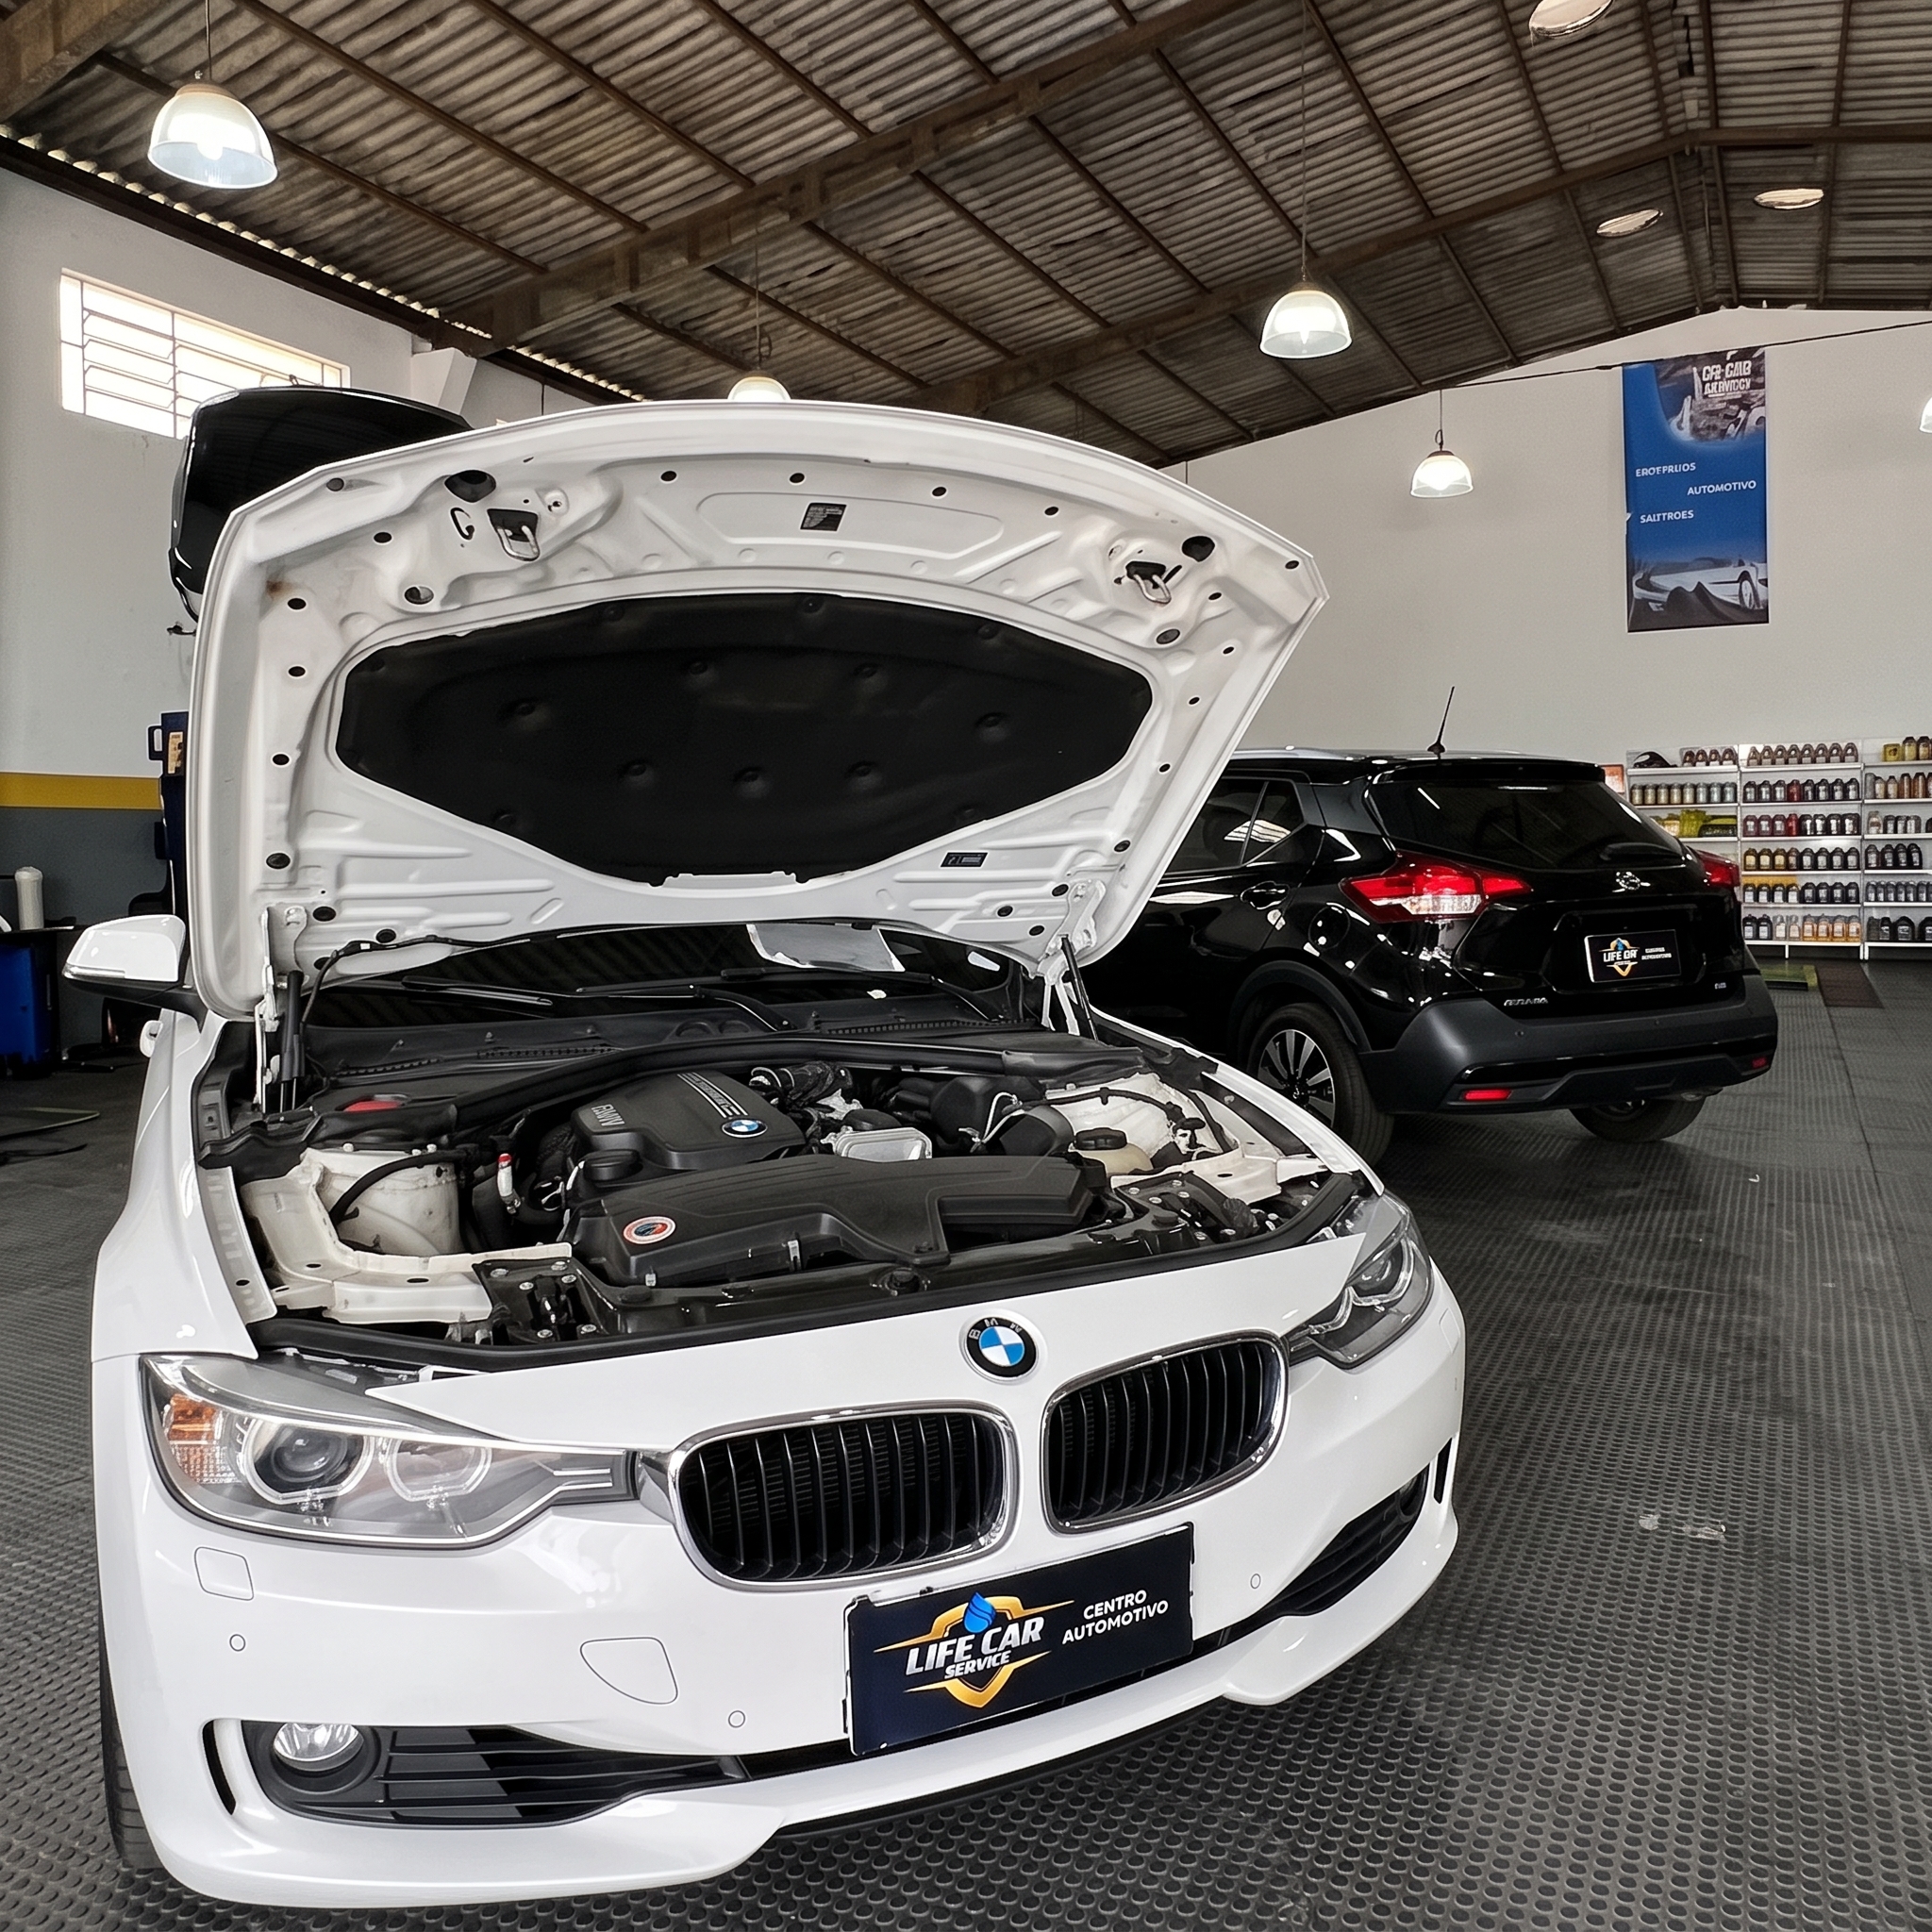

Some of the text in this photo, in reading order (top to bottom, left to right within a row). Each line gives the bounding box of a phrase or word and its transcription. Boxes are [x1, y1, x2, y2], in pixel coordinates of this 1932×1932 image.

[1688, 480, 1757, 495] AUTOMOTIVO
[1083, 1590, 1147, 1620] CENTRO
[1062, 1600, 1169, 1644] AUTOMOTIVO
[906, 1616, 1044, 1675] LIFE CAR
[944, 1650, 1011, 1679] SERVICE
